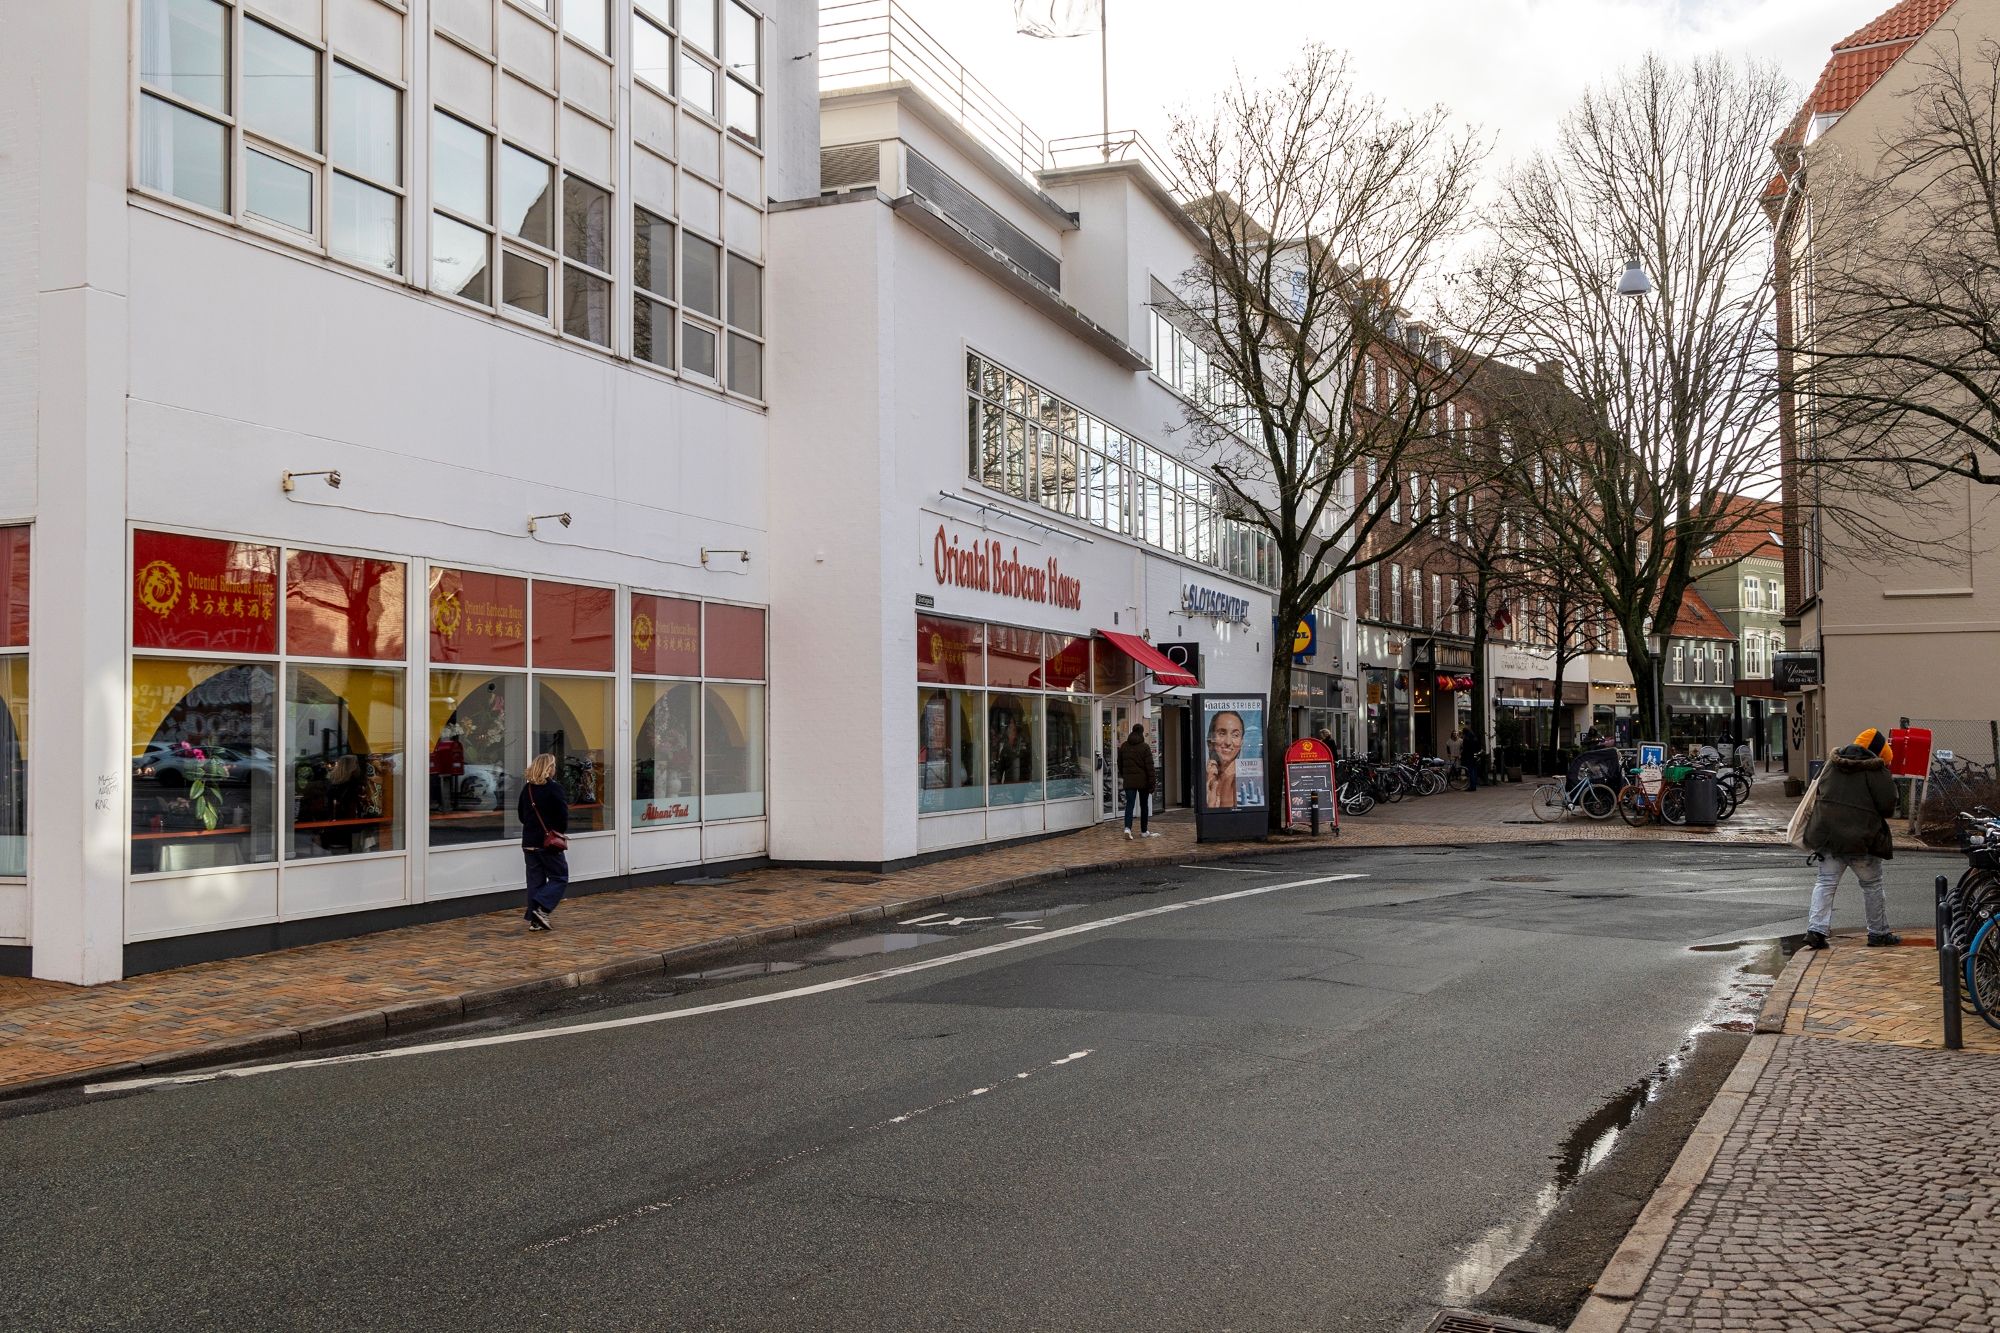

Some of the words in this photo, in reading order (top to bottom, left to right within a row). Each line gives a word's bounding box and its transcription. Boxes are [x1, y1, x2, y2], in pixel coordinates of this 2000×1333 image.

[188, 571, 217, 591] Oriental
[934, 523, 991, 593] Oriental
[992, 540, 1047, 604] Barbecue
[1047, 555, 1081, 611] House
[1188, 584, 1250, 623] SLOTSCENTRET
[1232, 701, 1261, 710] STRIBER
